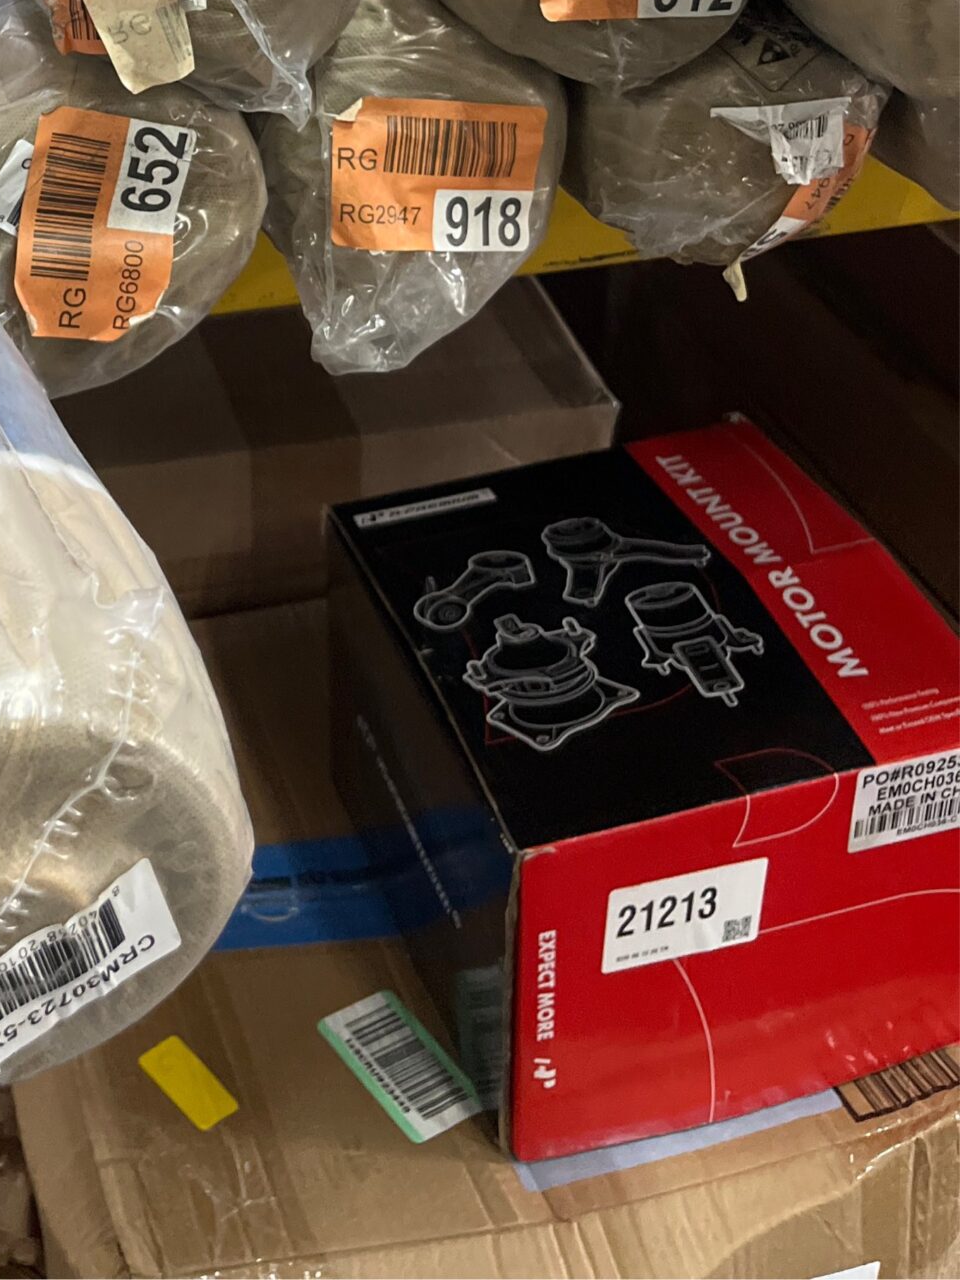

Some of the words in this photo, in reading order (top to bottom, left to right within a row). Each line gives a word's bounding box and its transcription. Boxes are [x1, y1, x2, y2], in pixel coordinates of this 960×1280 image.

[120, 126, 188, 213] 652
[337, 147, 378, 171] RG
[339, 203, 422, 226] RG2947
[445, 196, 522, 247] 918
[58, 287, 87, 329] RG
[112, 239, 145, 330] RG6800
[655, 454, 703, 486] KIT
[686, 487, 782, 565] MOUNT
[768, 566, 869, 677] MOTOR
[863, 755, 960, 789] PO#R0925
[868, 795, 916, 817] MADE
[920, 791, 937, 804] IN
[616, 886, 719, 939] 21213
[537, 929, 557, 989] EXPECT
[536, 992, 555, 1042] MORE
